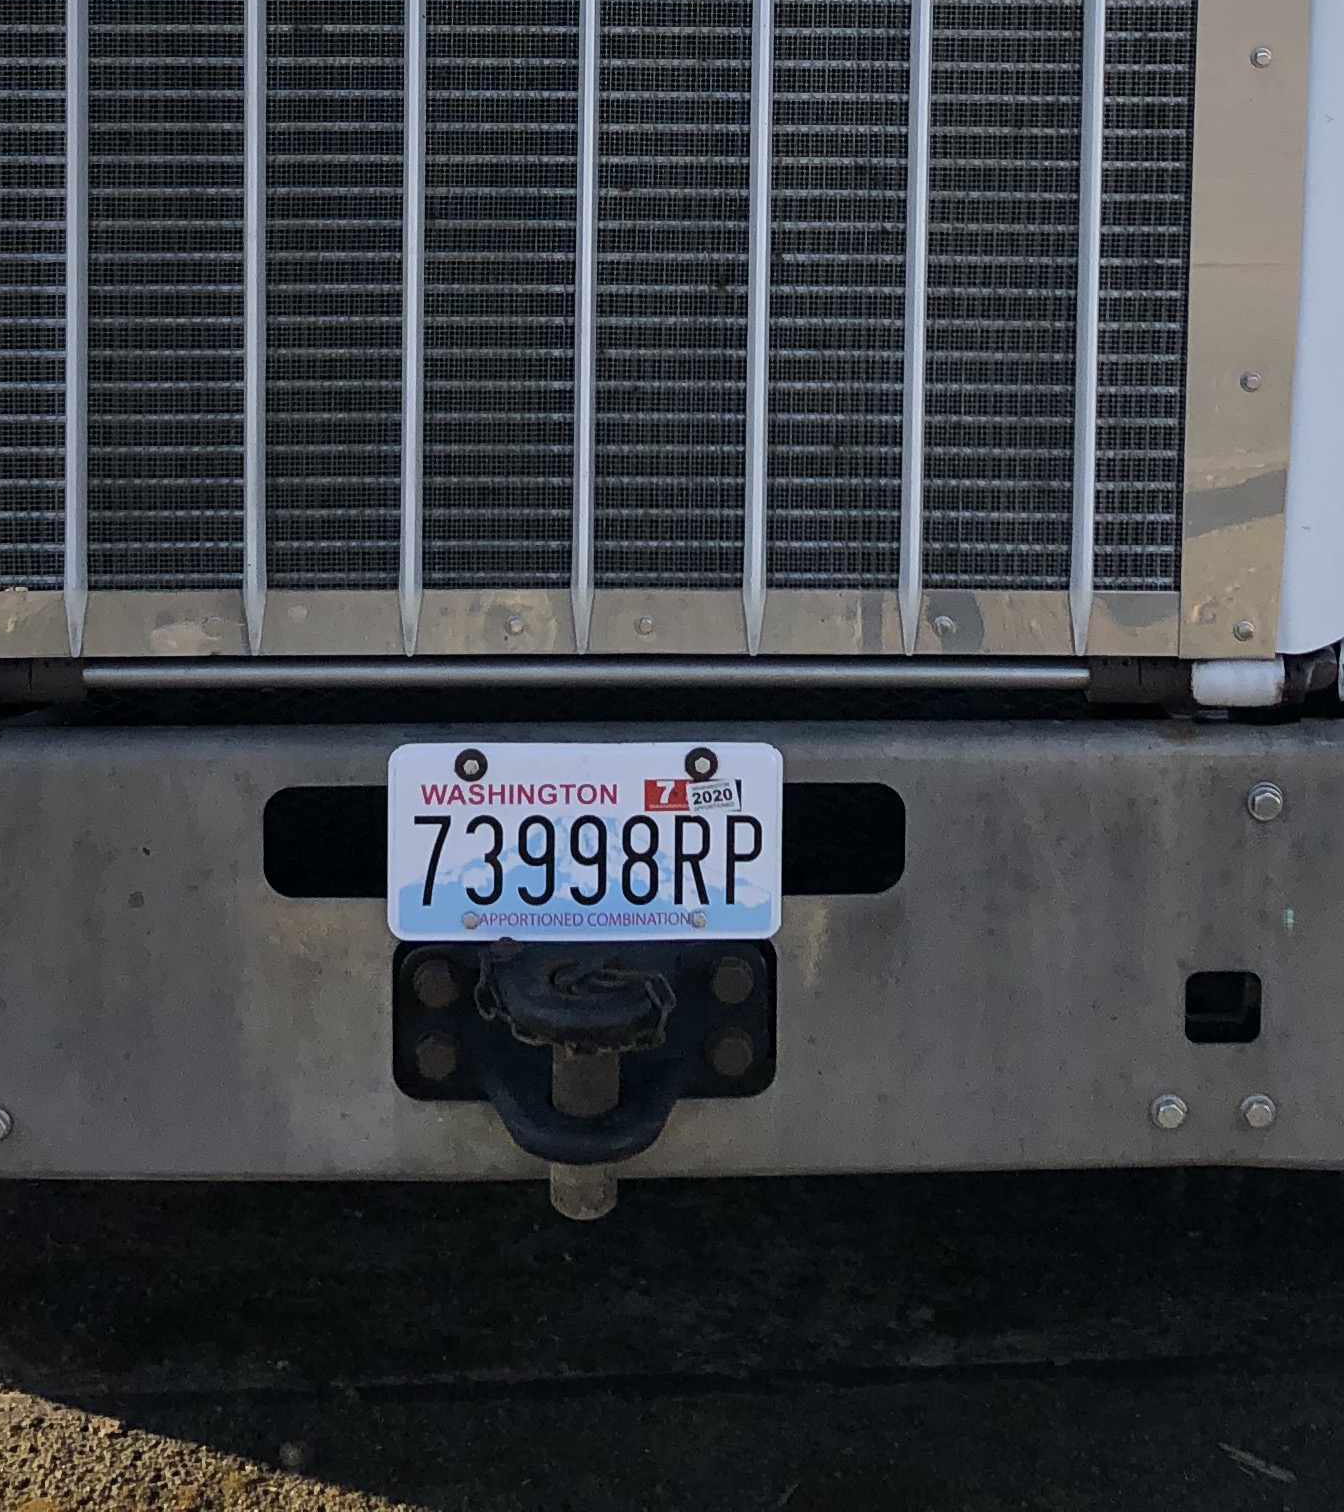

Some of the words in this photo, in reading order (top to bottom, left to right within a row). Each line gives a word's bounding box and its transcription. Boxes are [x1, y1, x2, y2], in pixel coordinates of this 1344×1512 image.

[421, 783, 618, 805] WASHINGTON
[656, 780, 675, 804] 7
[692, 788, 733, 805] 2020
[414, 814, 763, 907] 73998RP
[479, 912, 583, 927] APPORTIONED
[588, 912, 691, 927] COMBINATION
